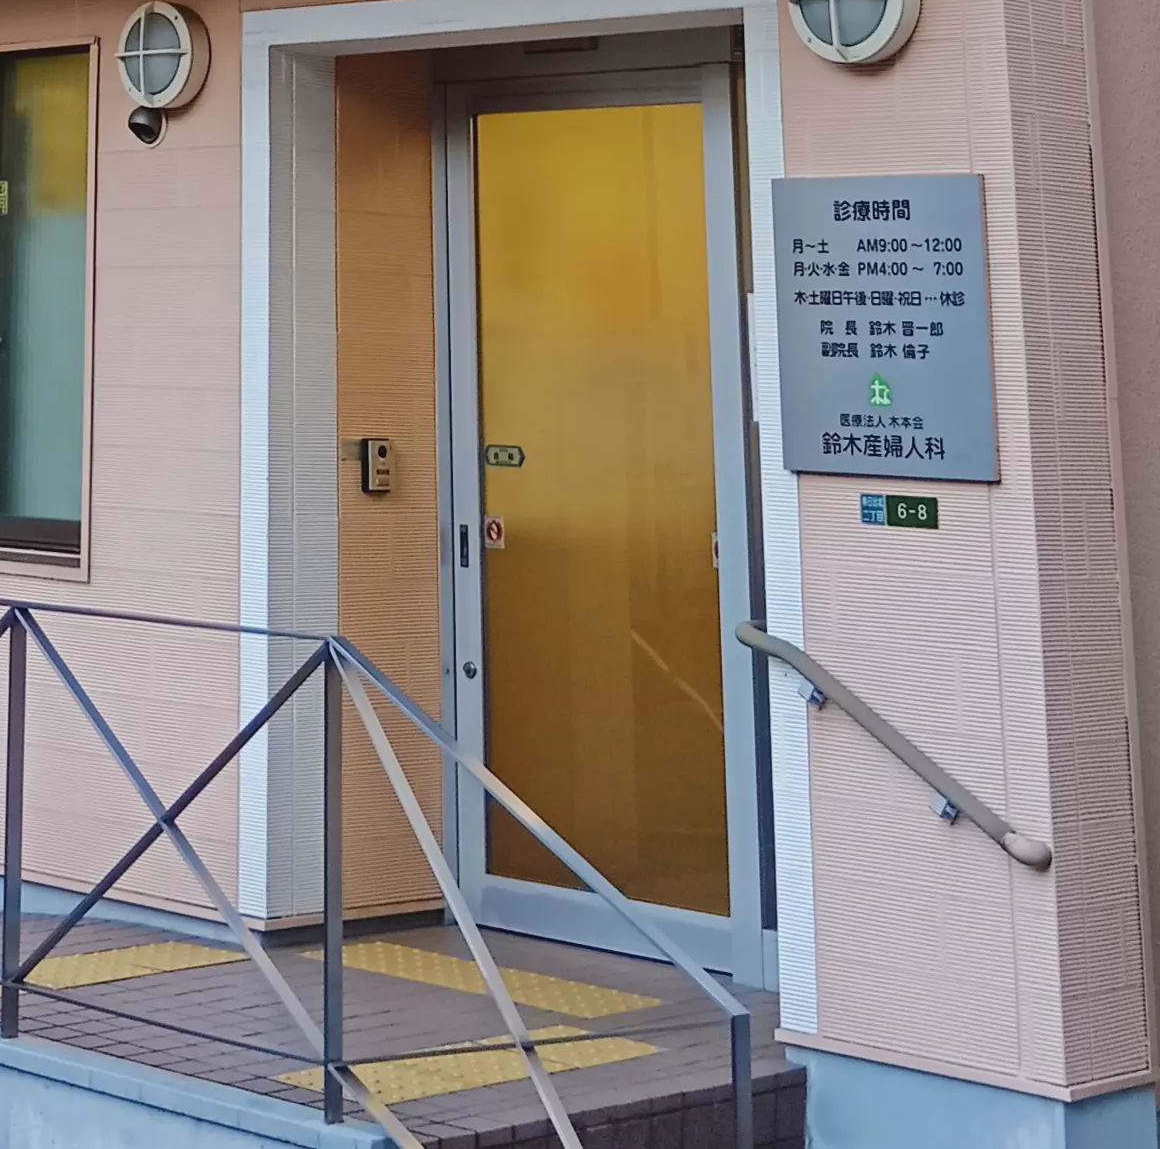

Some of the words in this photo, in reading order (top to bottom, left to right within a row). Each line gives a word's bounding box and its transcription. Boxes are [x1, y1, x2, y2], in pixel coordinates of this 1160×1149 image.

[833, 199, 911, 221] 診療時間
[821, 342, 859, 358] 副院長
[822, 432, 946, 461] 鈴木産婦人科
[897, 502, 928, 521] 6-8
